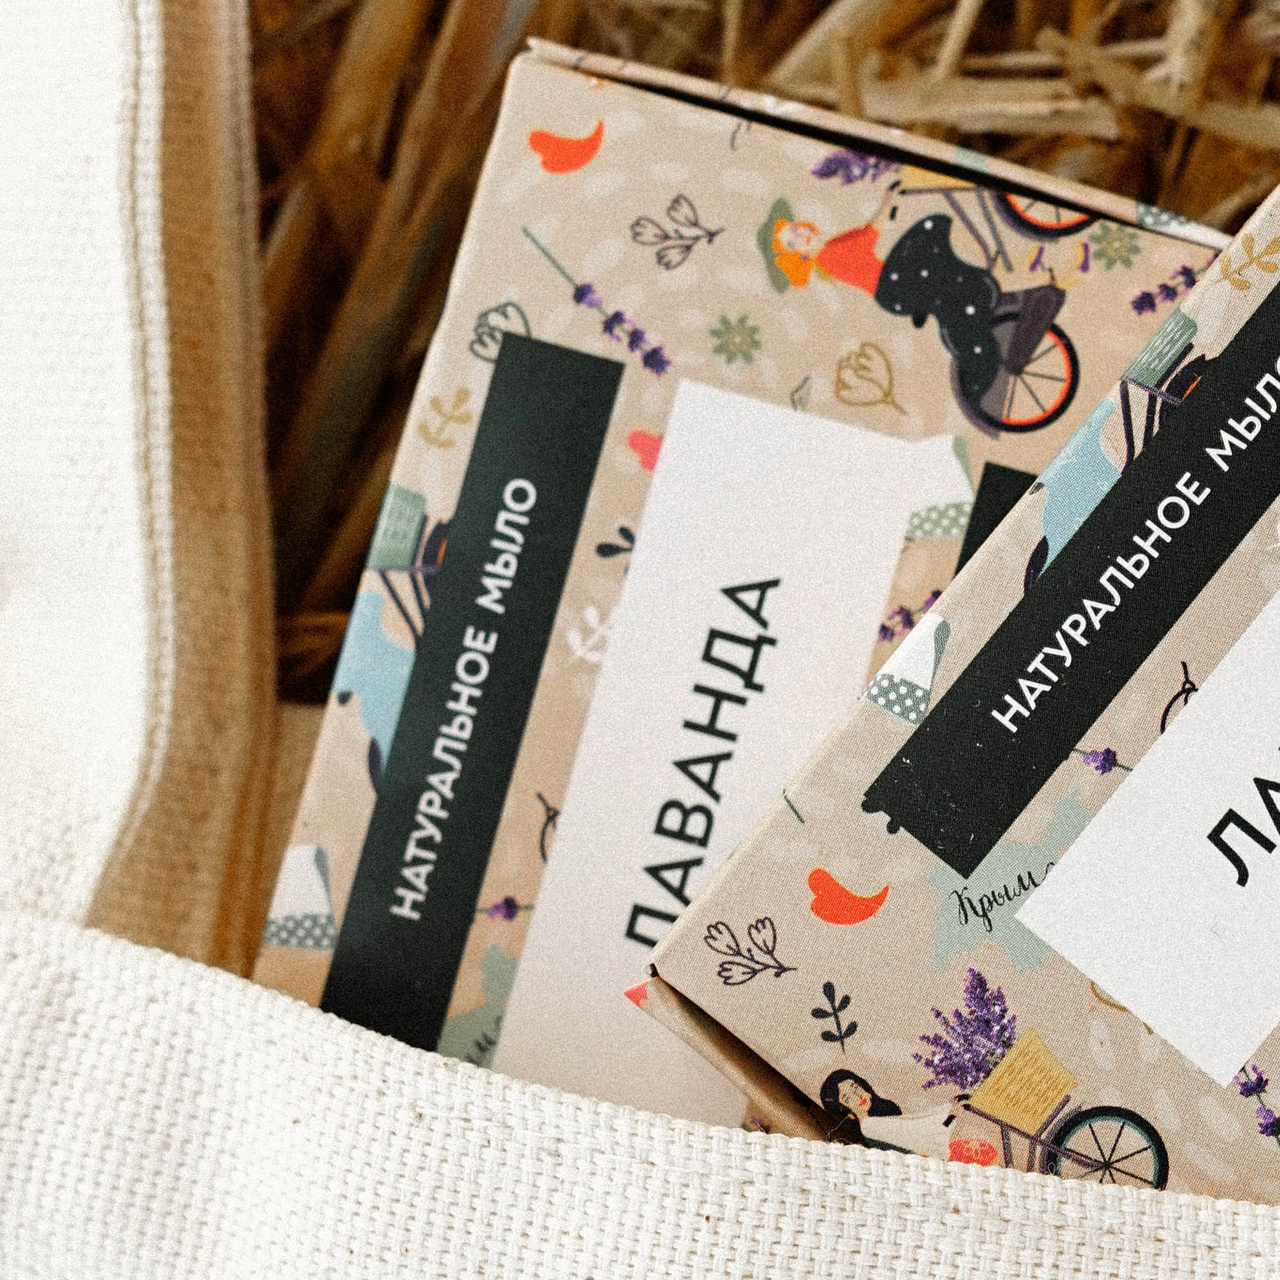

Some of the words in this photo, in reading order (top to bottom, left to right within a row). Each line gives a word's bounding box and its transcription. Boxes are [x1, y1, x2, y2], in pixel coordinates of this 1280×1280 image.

[391, 626, 498, 919] НАТУРАЛЬНОЕ
[476, 478, 537, 614] МЫЛО
[992, 472, 1210, 732] НАТУРАЛЬНОЕ
